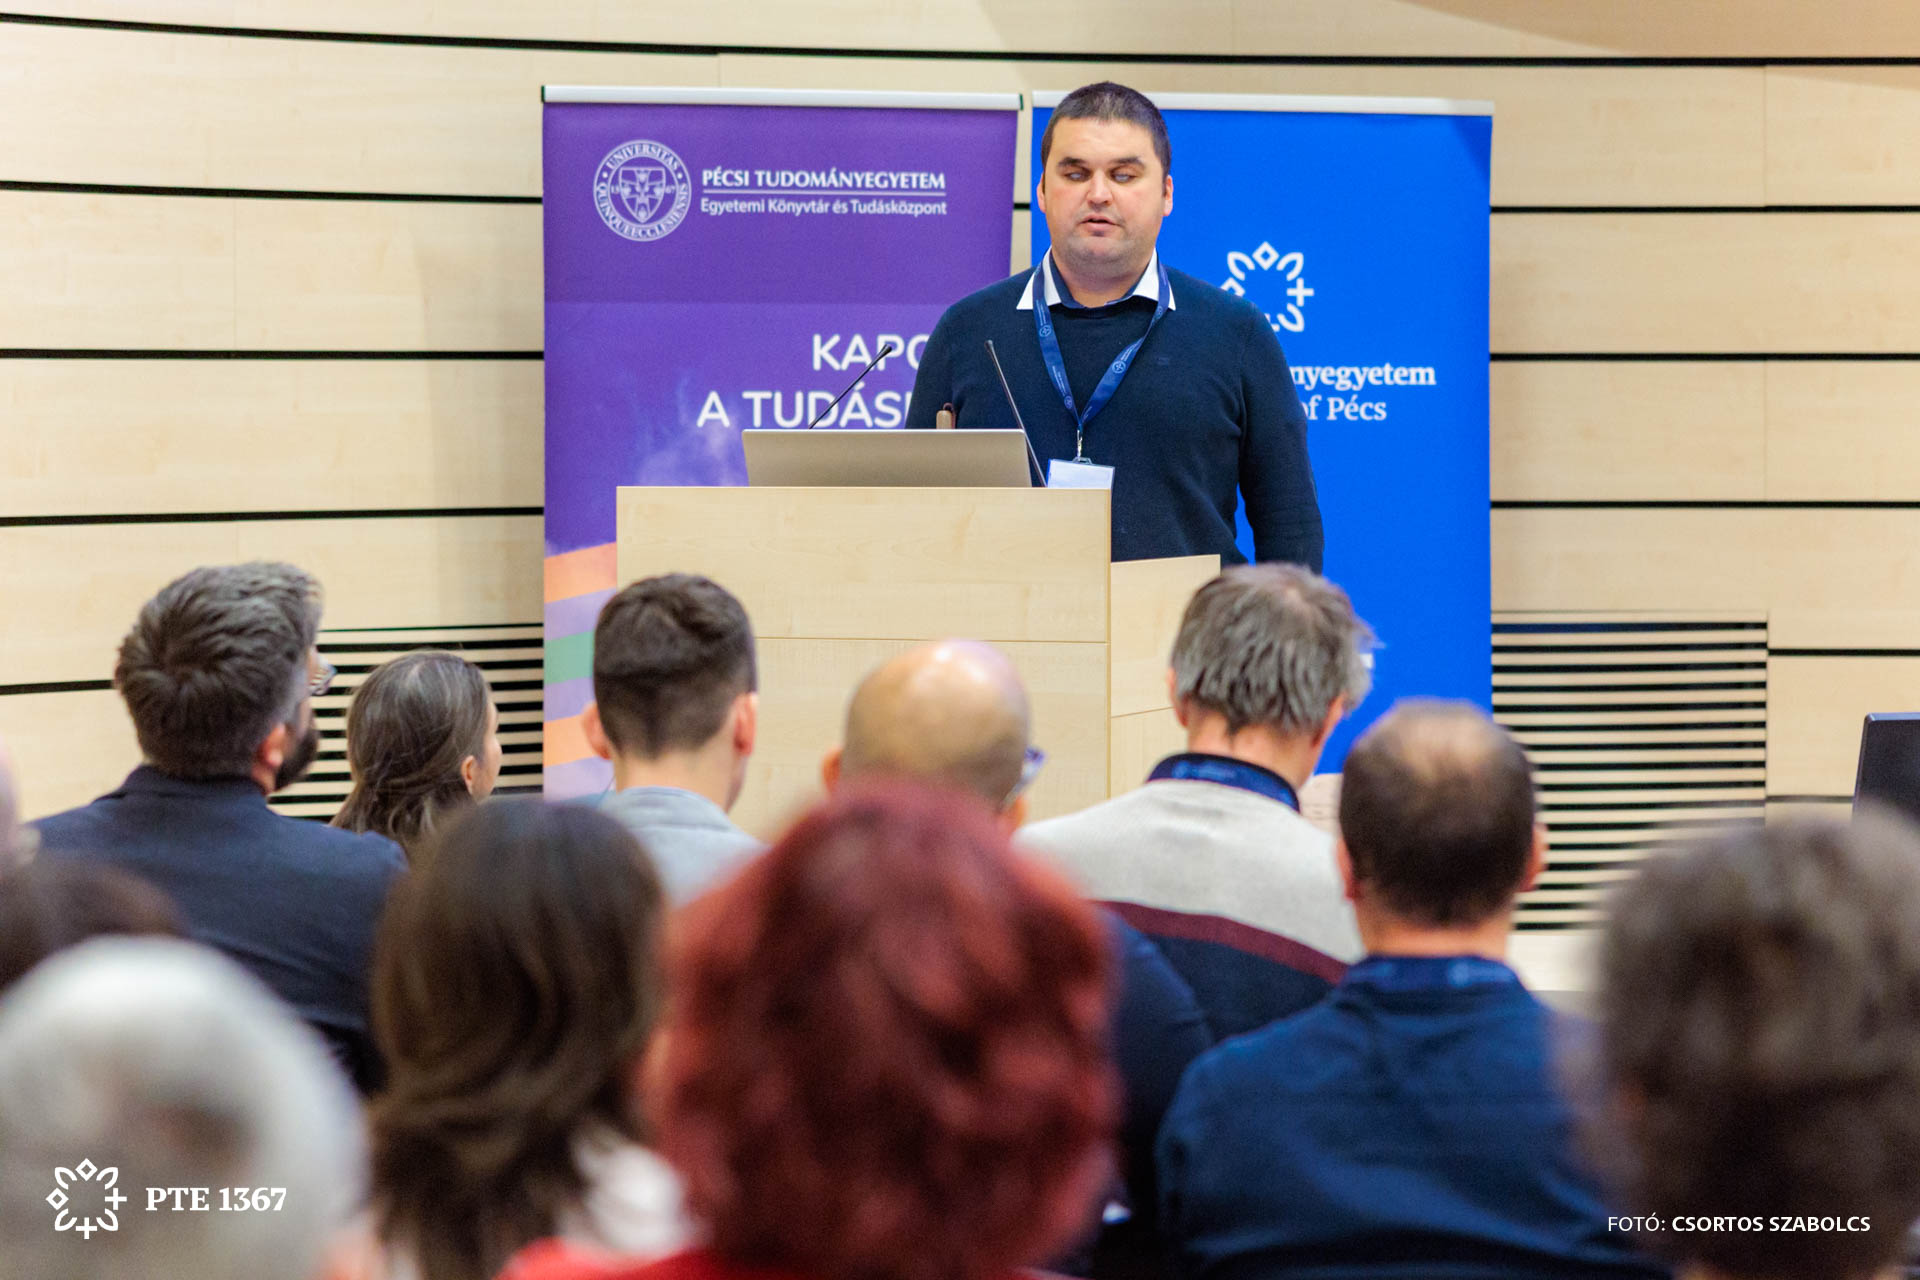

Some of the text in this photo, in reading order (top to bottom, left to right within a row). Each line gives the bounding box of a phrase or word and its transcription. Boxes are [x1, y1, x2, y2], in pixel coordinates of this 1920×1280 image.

[702, 165, 946, 190] PÉCSI TUDOMÁNYEGYETEM
[701, 197, 947, 218] Egyetemi Könyvtár és Tudásközpont
[1289, 362, 1437, 391] nyegyetem
[696, 390, 731, 428] A
[1326, 394, 1387, 421] Pécs
